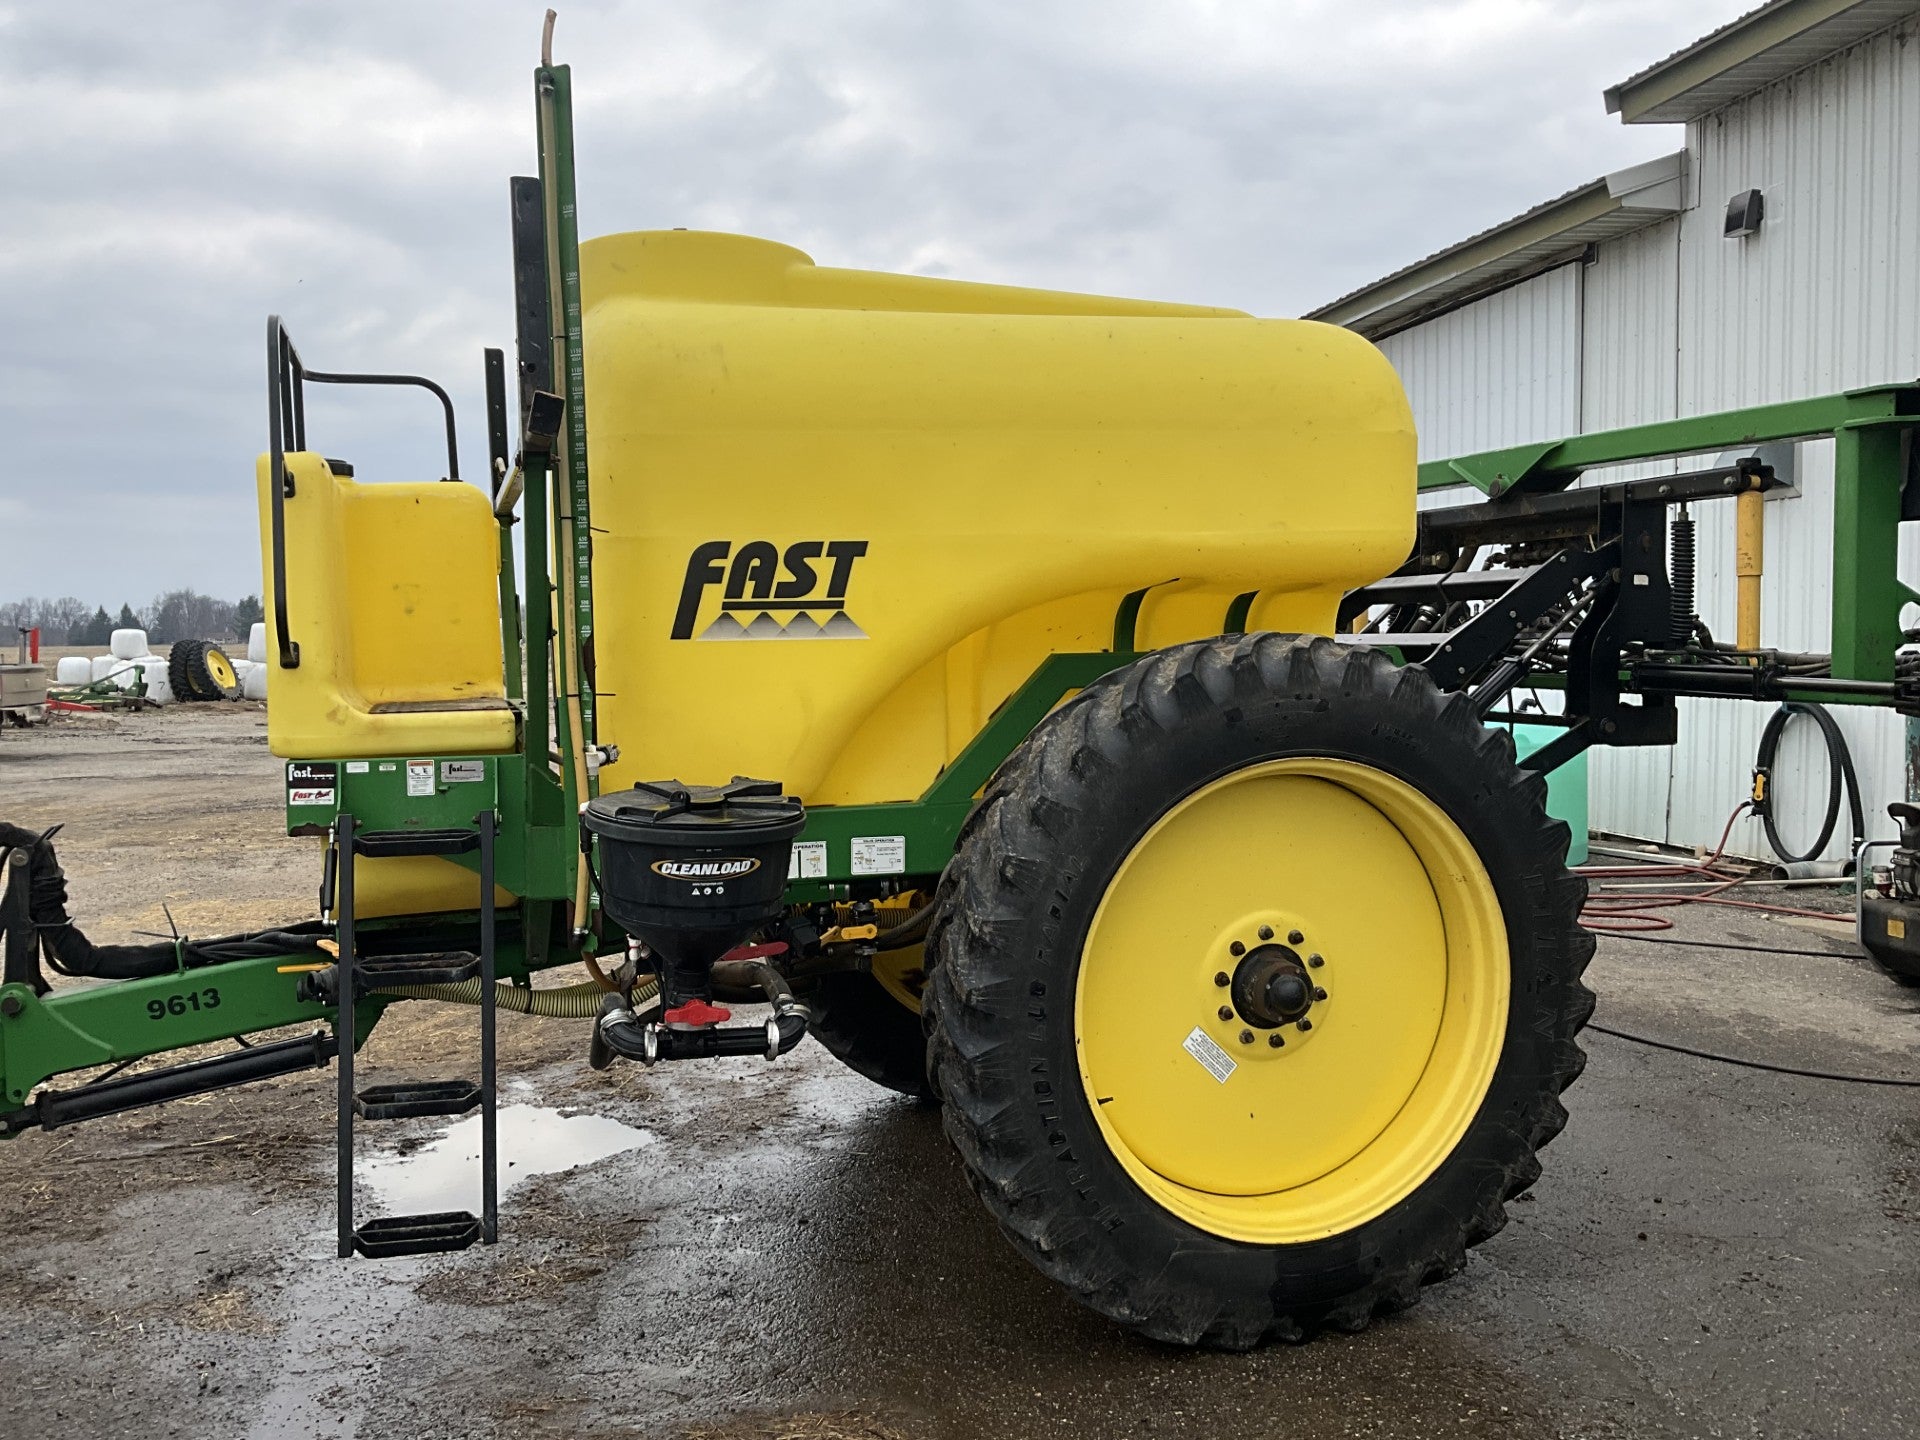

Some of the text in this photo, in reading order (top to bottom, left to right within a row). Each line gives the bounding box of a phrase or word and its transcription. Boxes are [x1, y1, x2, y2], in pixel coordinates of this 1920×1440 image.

[670, 540, 869, 640] FAST
[288, 763, 312, 781] fast
[661, 860, 752, 876] CLEANLOAD
[147, 987, 221, 1020] 9613
